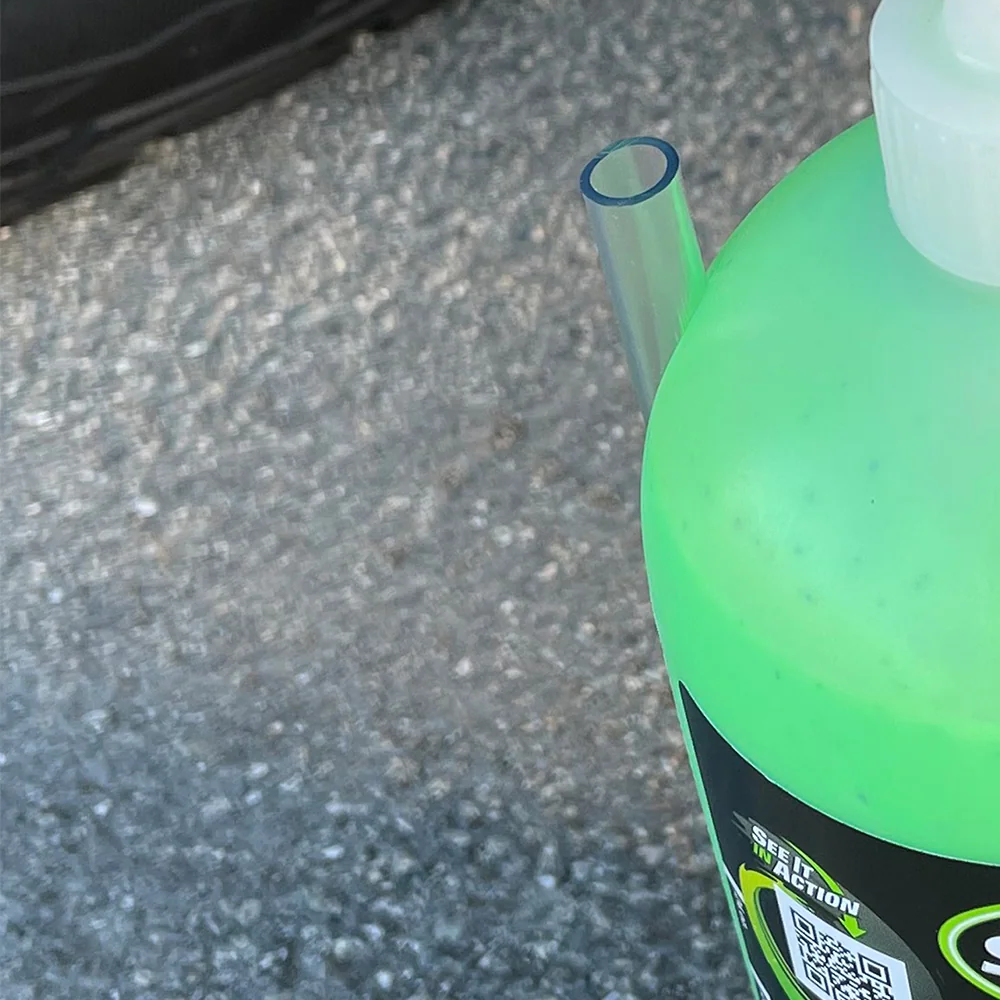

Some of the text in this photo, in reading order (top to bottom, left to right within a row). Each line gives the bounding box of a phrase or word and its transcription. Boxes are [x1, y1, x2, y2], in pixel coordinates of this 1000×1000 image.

[751, 824, 814, 880] SEE IT
[752, 842, 773, 865] IN
[772, 862, 860, 917] ACTION
